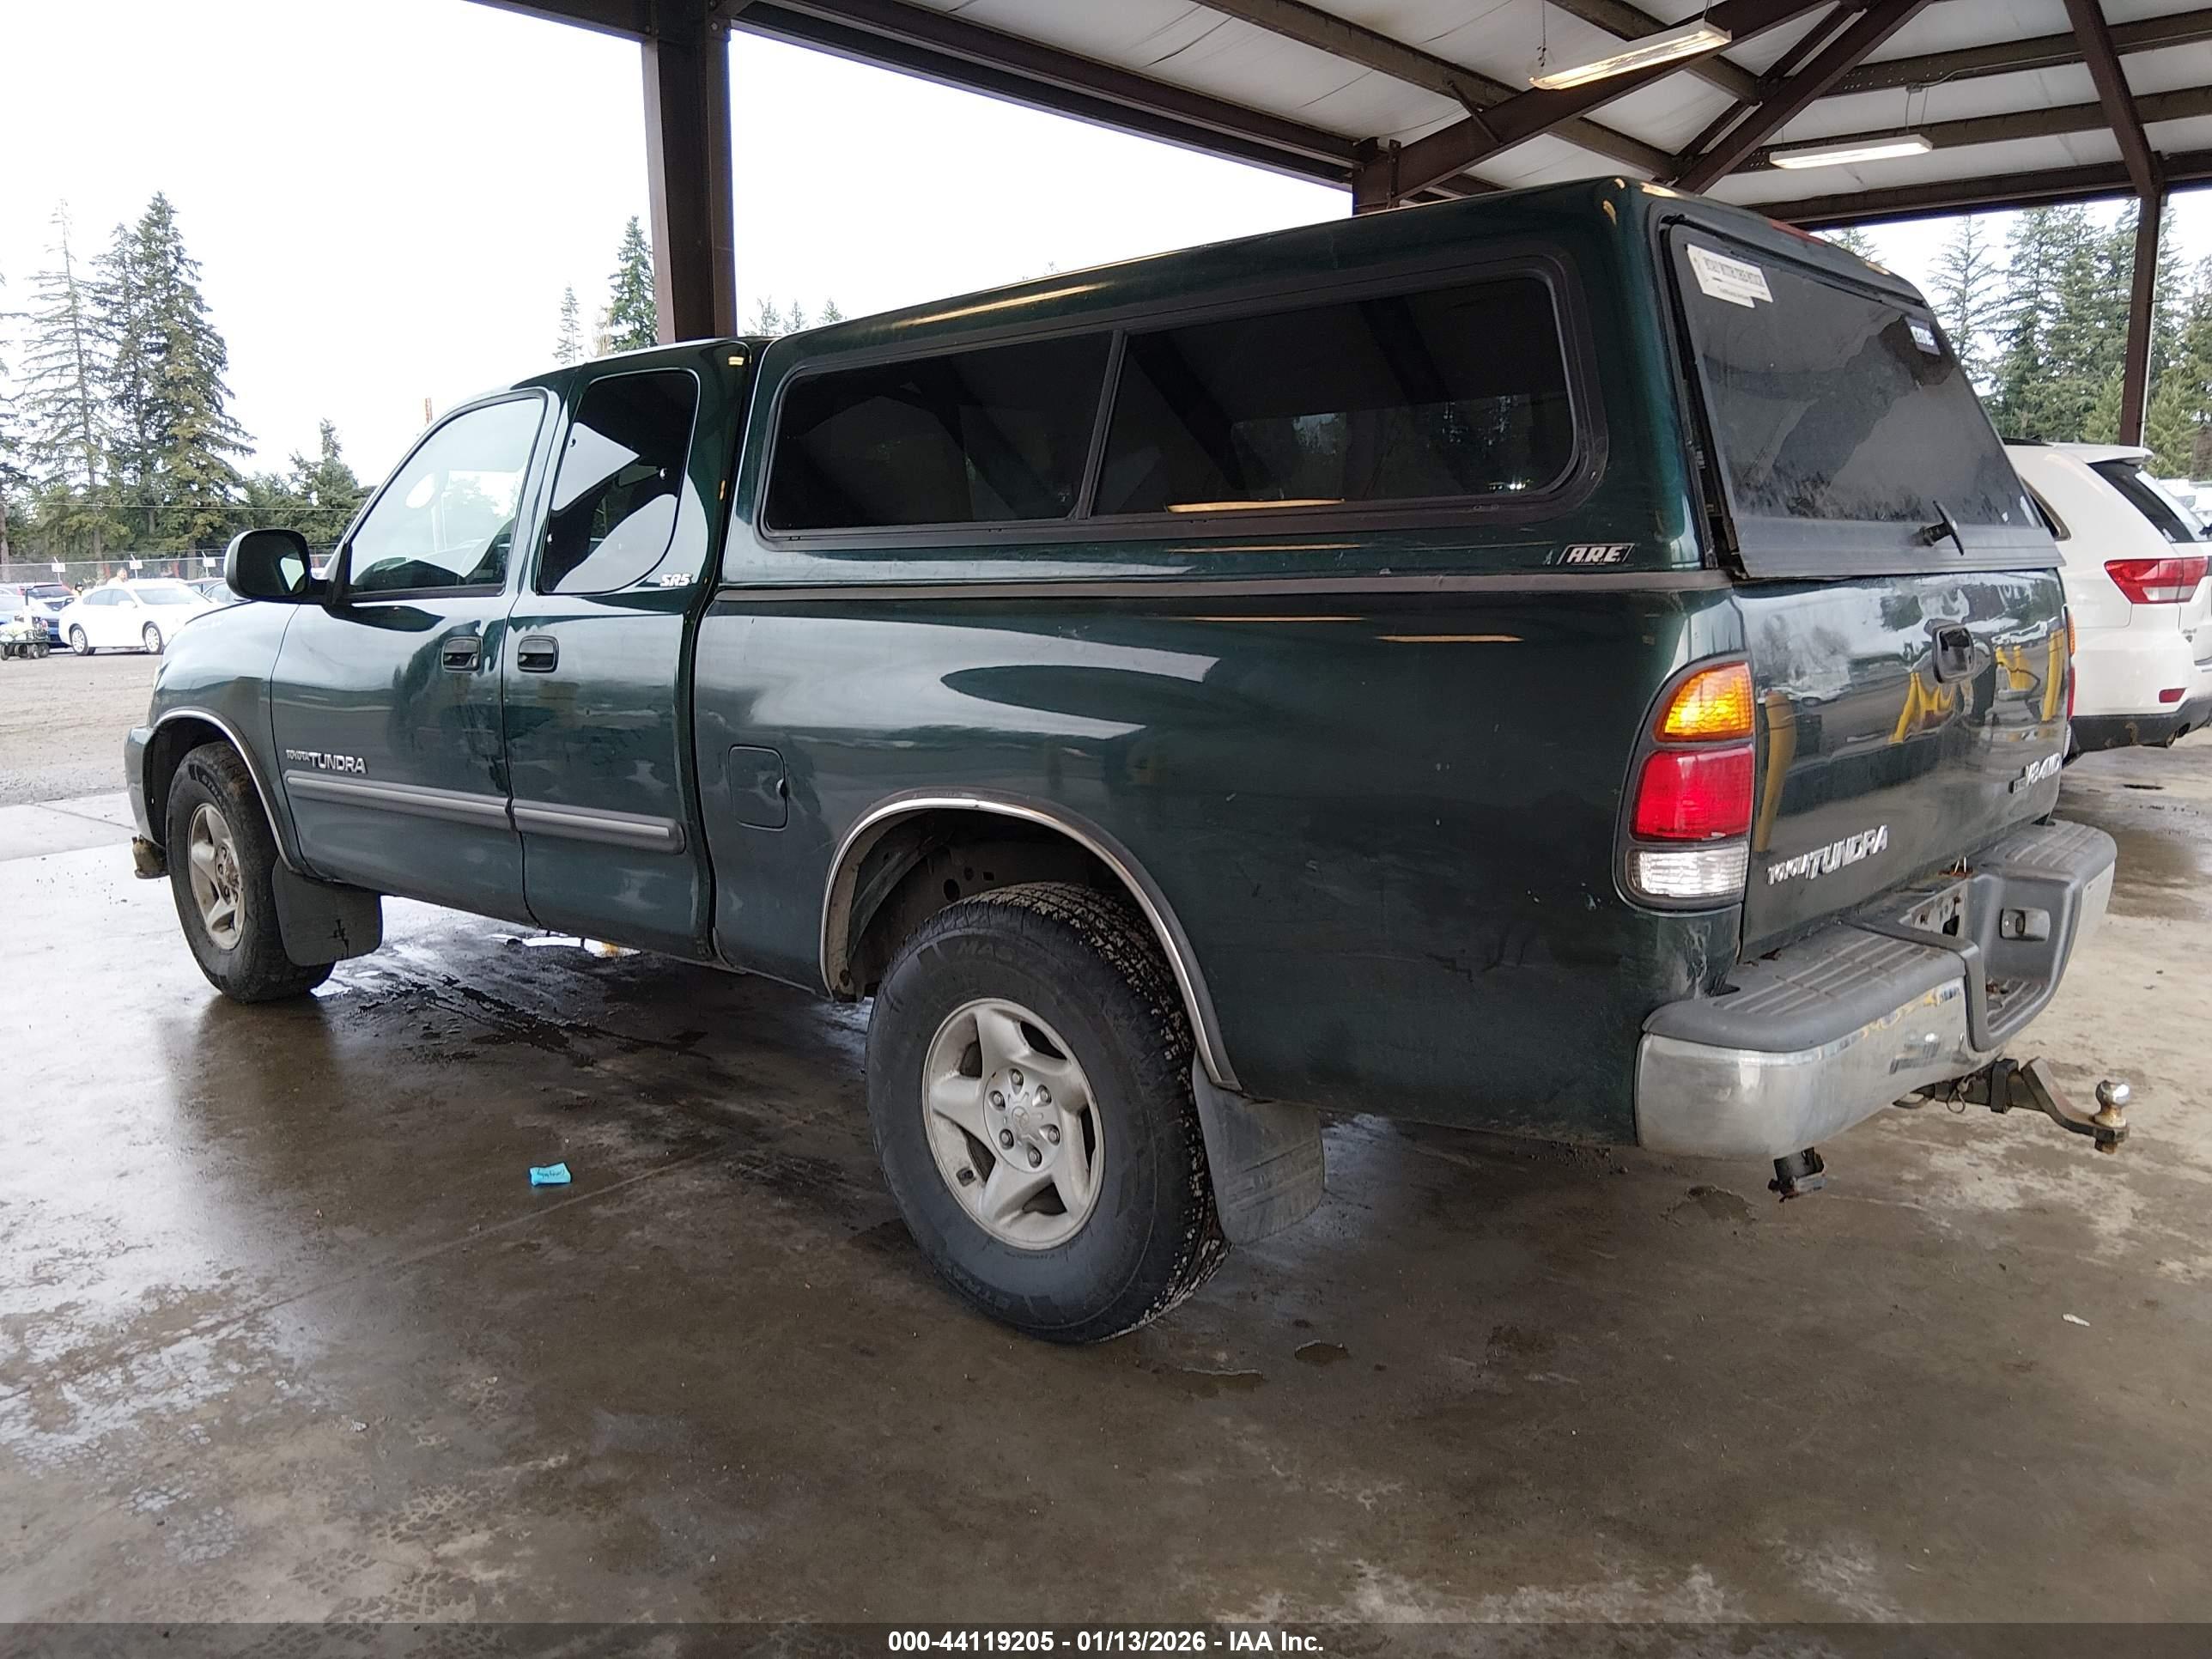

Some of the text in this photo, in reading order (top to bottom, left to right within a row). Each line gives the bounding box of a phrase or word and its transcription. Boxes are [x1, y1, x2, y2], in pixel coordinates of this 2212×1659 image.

[659, 573, 693, 587] SR5
[286, 749, 368, 774] TOYOTA TUNDRA
[1766, 824, 1888, 886] TOYOTA TUNDRA
